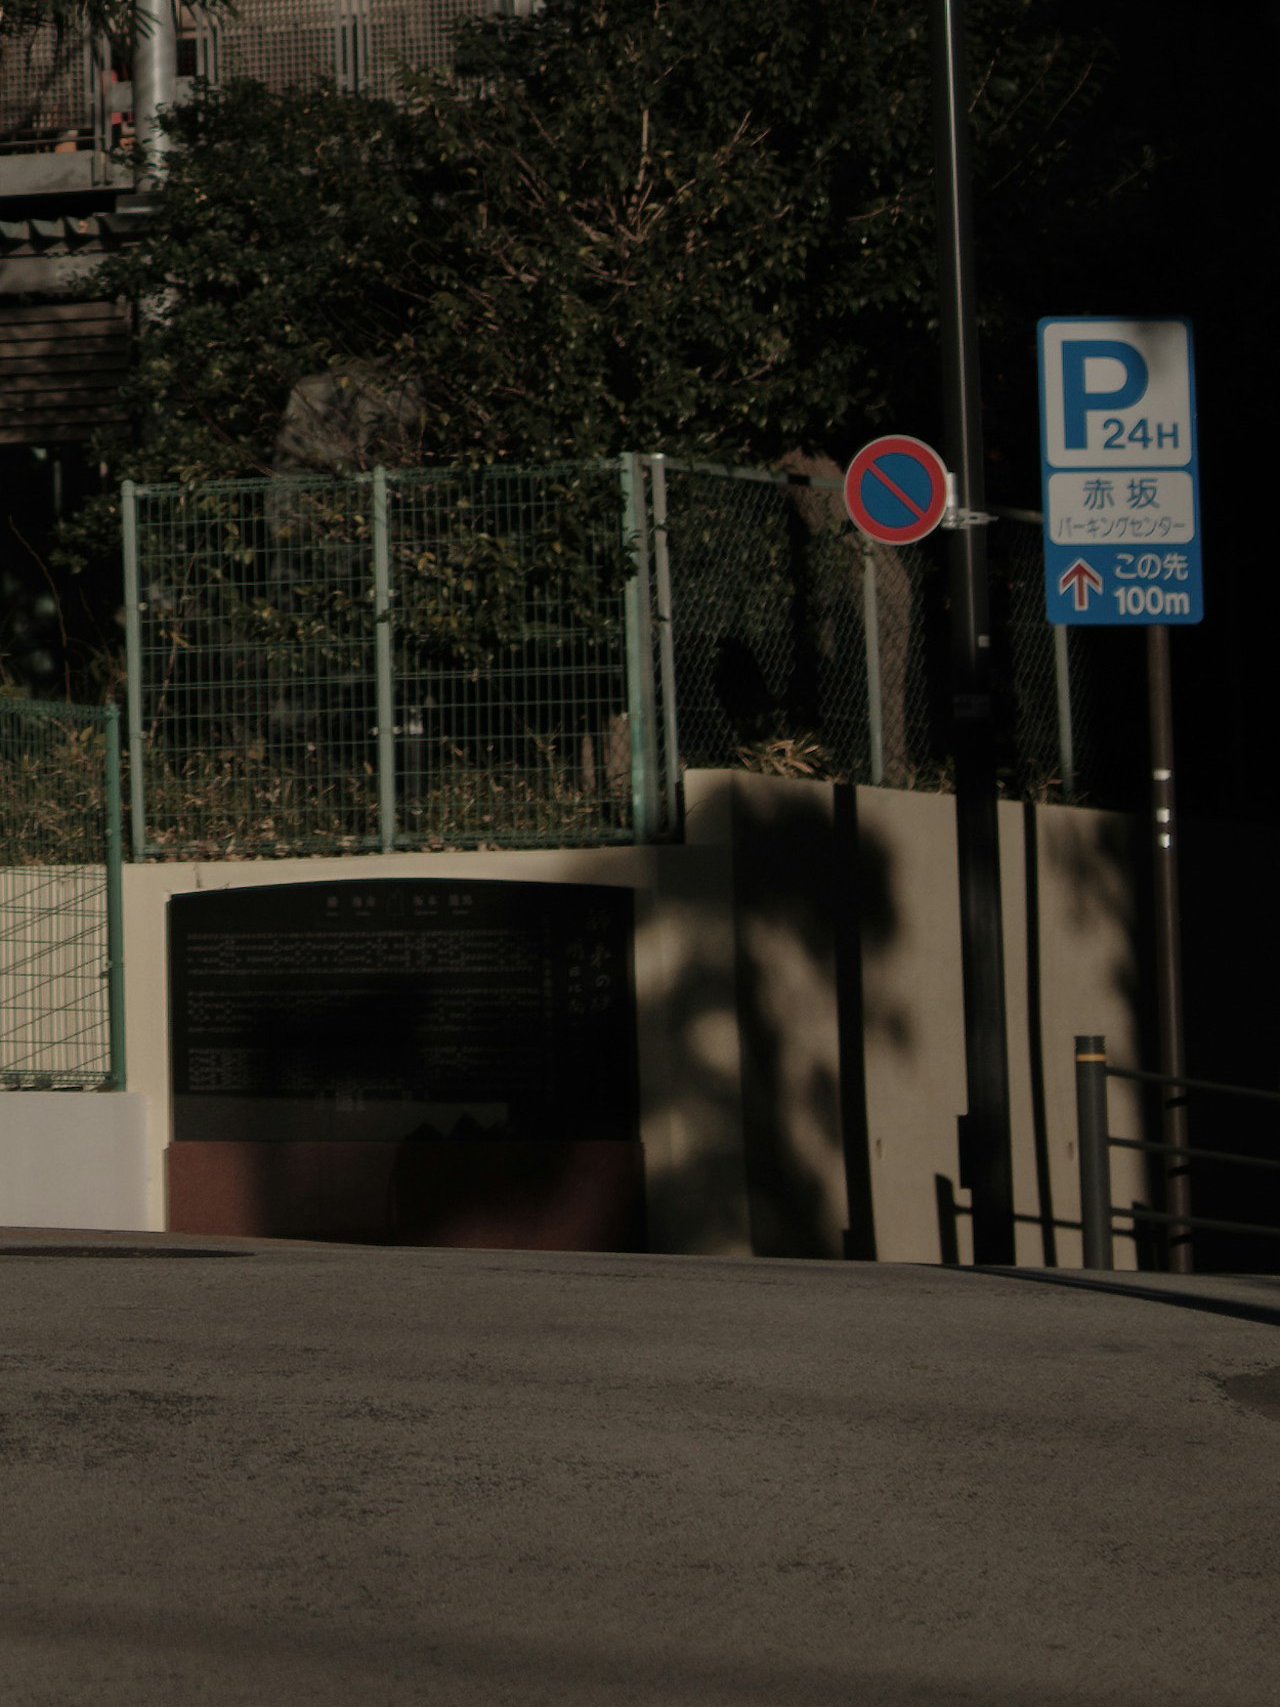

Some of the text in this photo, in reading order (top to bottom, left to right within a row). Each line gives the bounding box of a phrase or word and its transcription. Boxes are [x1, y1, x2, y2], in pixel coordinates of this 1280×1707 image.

[1062, 340, 1147, 449] P
[1103, 419, 1179, 449] 24H
[1083, 477, 1159, 511] 赤坂
[1057, 515, 1186, 540] パーキングセンター
[1114, 553, 1189, 582] この先
[1114, 586, 1190, 615] 100m
